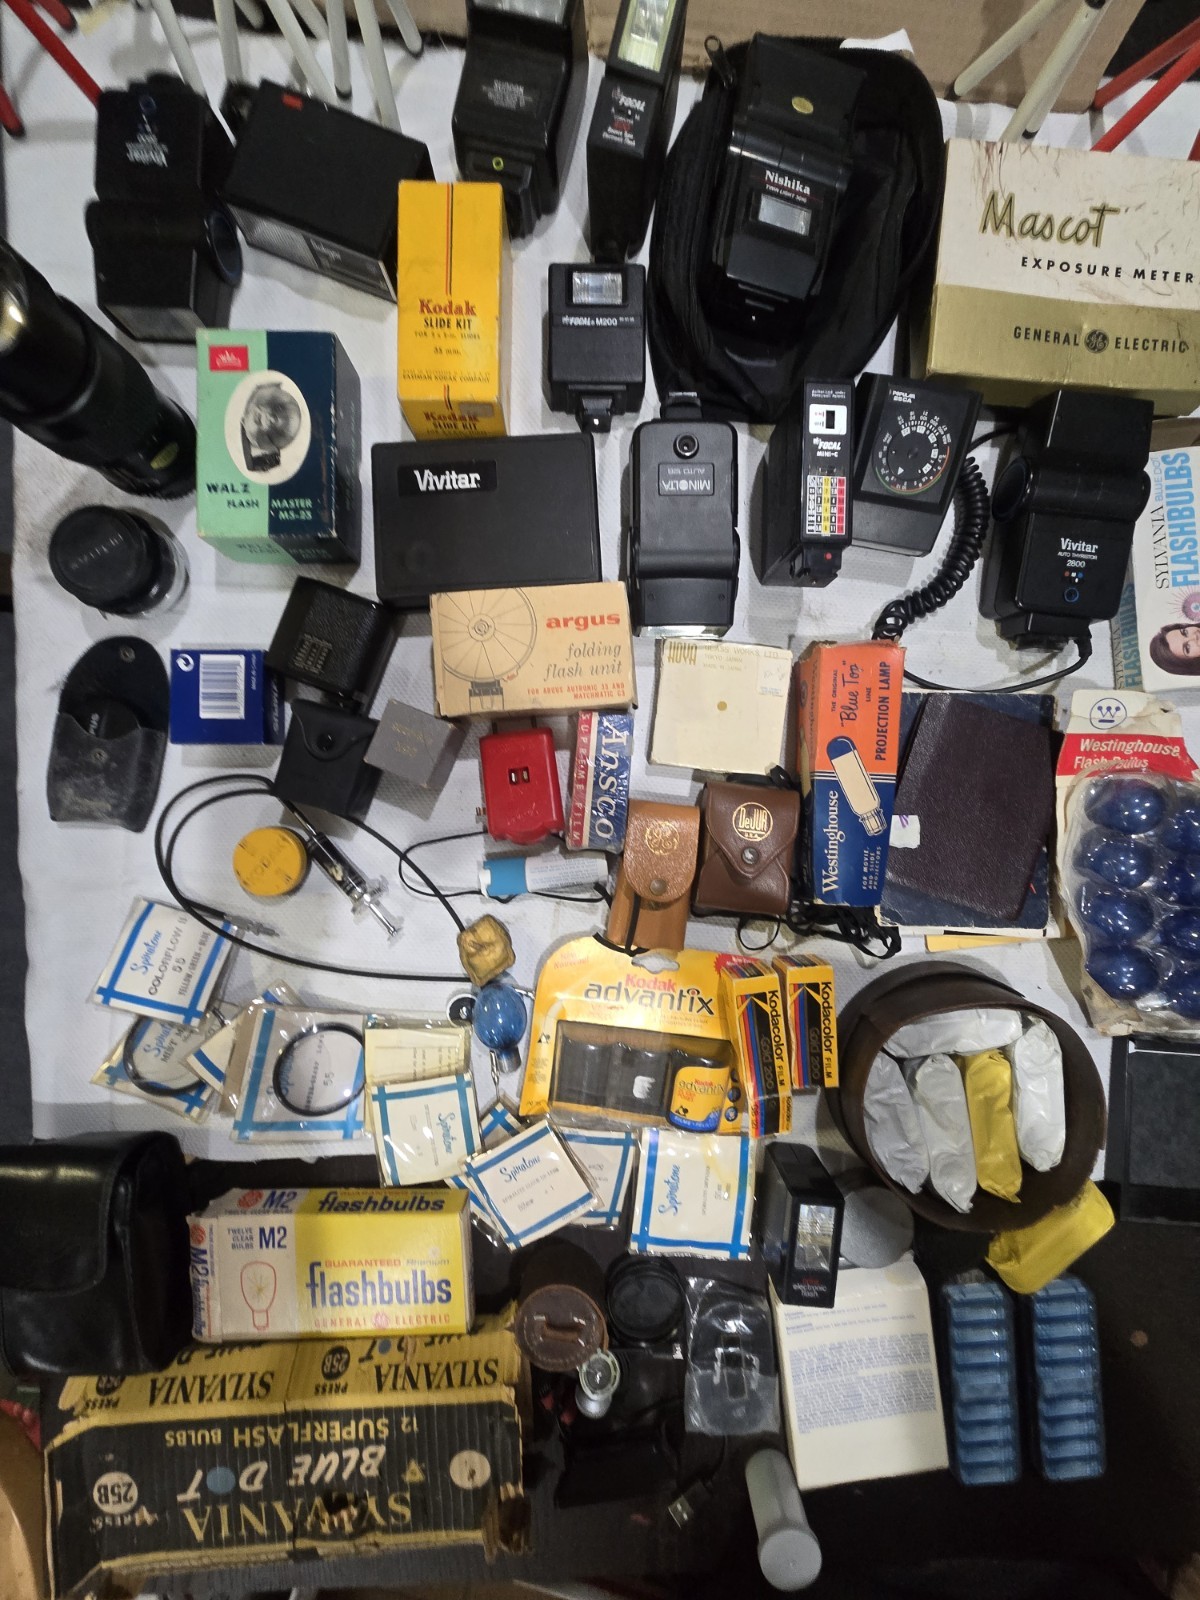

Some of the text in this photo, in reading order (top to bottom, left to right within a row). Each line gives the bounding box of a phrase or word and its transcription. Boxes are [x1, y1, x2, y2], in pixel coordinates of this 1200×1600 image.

[765, 170, 811, 195] Nishika
[979, 189, 1121, 249] Mascot
[1021, 256, 1194, 283] EXPOSURE METER
[419, 298, 477, 316] Kodak
[424, 318, 472, 331] SLIDE KIT
[1013, 326, 1080, 346] GENERAL
[1115, 337, 1188, 353] ELECTRIC
[434, 374, 457, 382] KODAK
[460, 375, 490, 383] COMPANY
[424, 411, 479, 423] Kodak
[432, 422, 478, 431] SLIDE KIT
[817, 441, 842, 450] FOCAL
[413, 469, 480, 492] Vivitar
[683, 467, 705, 475] AUTO
[206, 483, 250, 494] WALZ
[661, 479, 711, 491] MINOLTA
[227, 498, 312, 509] FLASH MASTER
[1150, 457, 1170, 590] SYLVANIA BLUE DOT
[1161, 452, 1200, 588] FLASHBULBS
[1060, 537, 1099, 553] Vivitar
[1066, 560, 1086, 568] 2800
[546, 613, 621, 631] argus
[566, 641, 622, 661] folding
[667, 641, 698, 666] HOYA
[1111, 622, 1126, 690] SYLVANIA
[544, 660, 622, 682] flash unit
[527, 687, 540, 696] FOR
[543, 687, 564, 695] ARGUS
[612, 682, 625, 690] AND
[875, 661, 891, 761] PROJECTION LAMP
[576, 712, 591, 791] SUPREME
[1080, 738, 1181, 757] Westinghouse
[1074, 756, 1108, 769] Flash
[572, 802, 583, 840] FILM
[822, 790, 846, 894] Westinghouse
[873, 847, 882, 891] PROJECTORS
[148, 927, 184, 996] COLORFLOW
[625, 974, 677, 993] Kodak
[584, 981, 715, 1016] advantix
[768, 990, 786, 1087] Kodacolor FILM
[821, 981, 833, 1079] Kodacolor FILM
[763, 1065, 774, 1090] 200
[811, 1057, 821, 1080] 200
[499, 1155, 541, 1184] Spiratone
[262, 1191, 297, 1210] M2
[317, 1191, 445, 1212] flashbulbs
[227, 1226, 253, 1236] TWELVE
[232, 1235, 254, 1243] CLEAR
[258, 1226, 288, 1250] M2
[231, 1242, 254, 1250] BULBS
[191, 1247, 209, 1277] M2
[325, 1258, 450, 1268] GUARANTEED Rhenium
[305, 1260, 452, 1308] flashbulbs
[792, 1282, 827, 1292] electronic
[801, 1290, 819, 1298] flash
[314, 1314, 450, 1328] GENERAL ELECTRIC
[324, 1352, 349, 1367] 25B
[374, 1358, 499, 1394] SYLVANIA
[148, 1370, 275, 1407] SYLVANIA
[314, 1382, 348, 1395] PRESS
[84, 1396, 121, 1411] PRESS
[165, 1415, 419, 1448] 12 SUPERFLASH BULBS
[287, 1444, 386, 1487] BLUE
[97, 1481, 134, 1506] 25B
